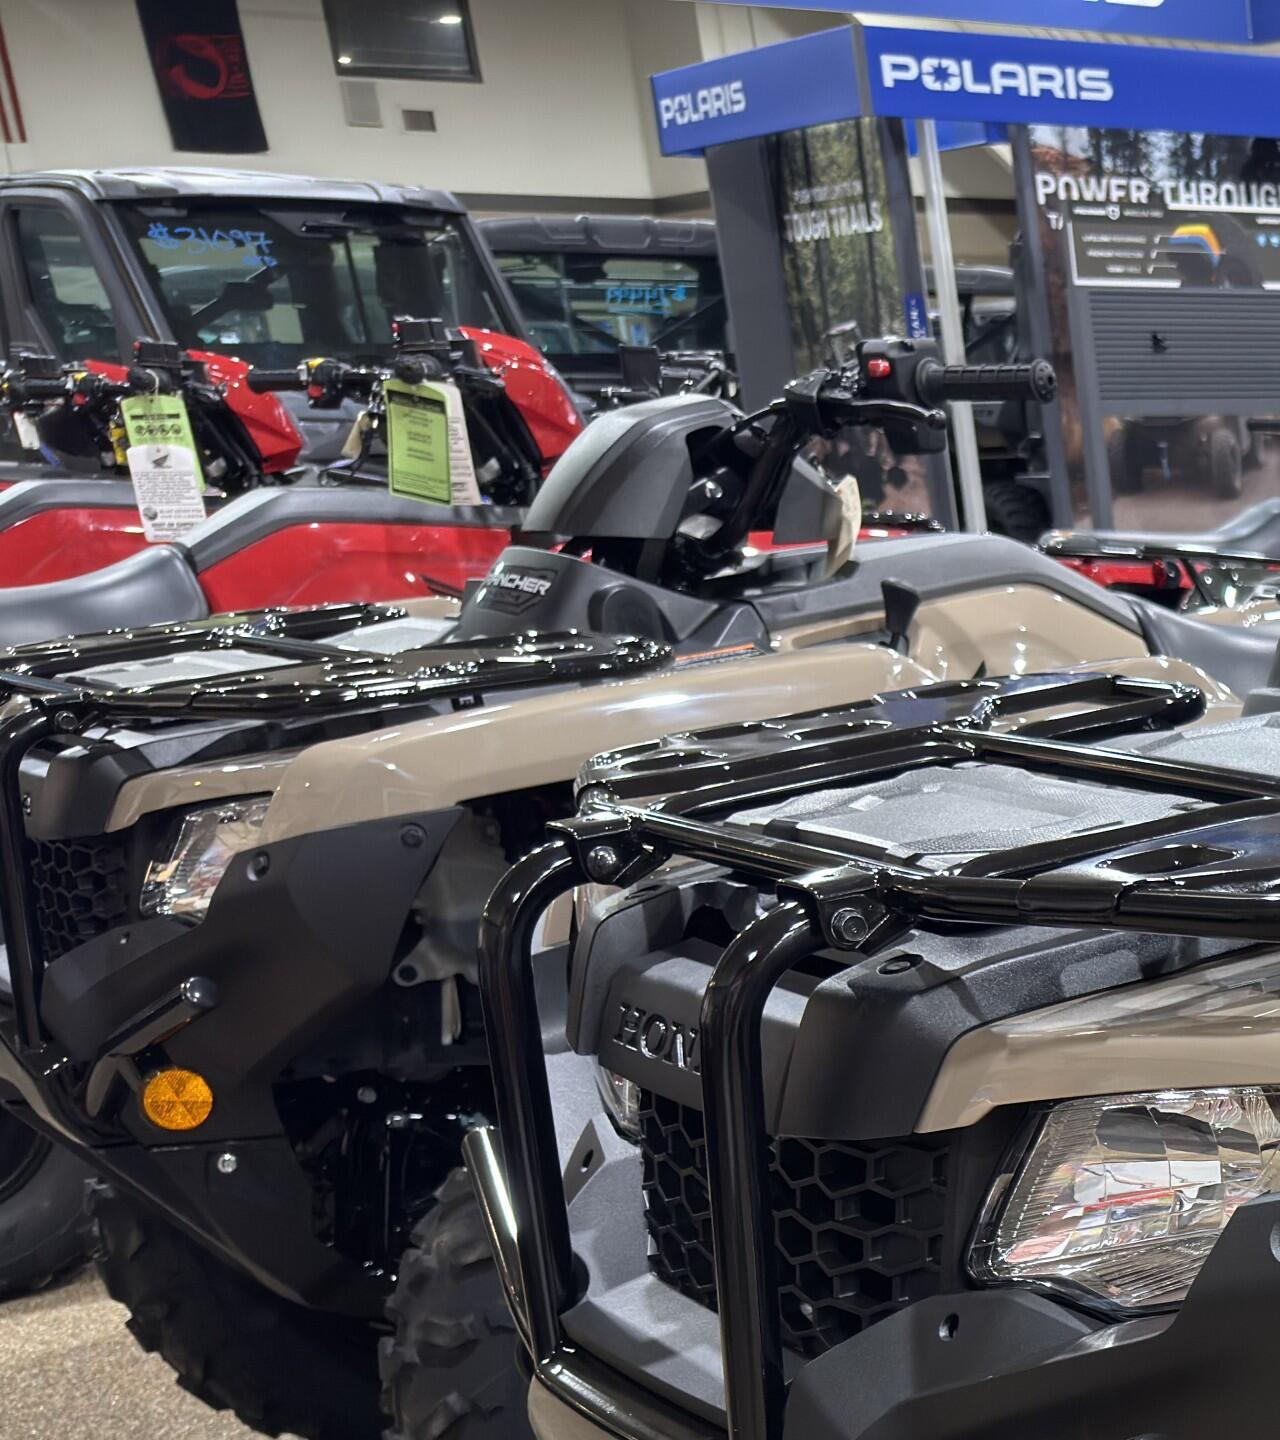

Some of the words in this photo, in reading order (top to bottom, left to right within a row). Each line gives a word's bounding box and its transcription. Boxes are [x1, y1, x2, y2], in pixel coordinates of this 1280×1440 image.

[879, 53, 1115, 103] POLARIS
[659, 80, 747, 128] POLARIS
[1035, 174, 1149, 205] POWER
[487, 572, 552, 597] ANCHER
[612, 1002, 701, 1076] HON
